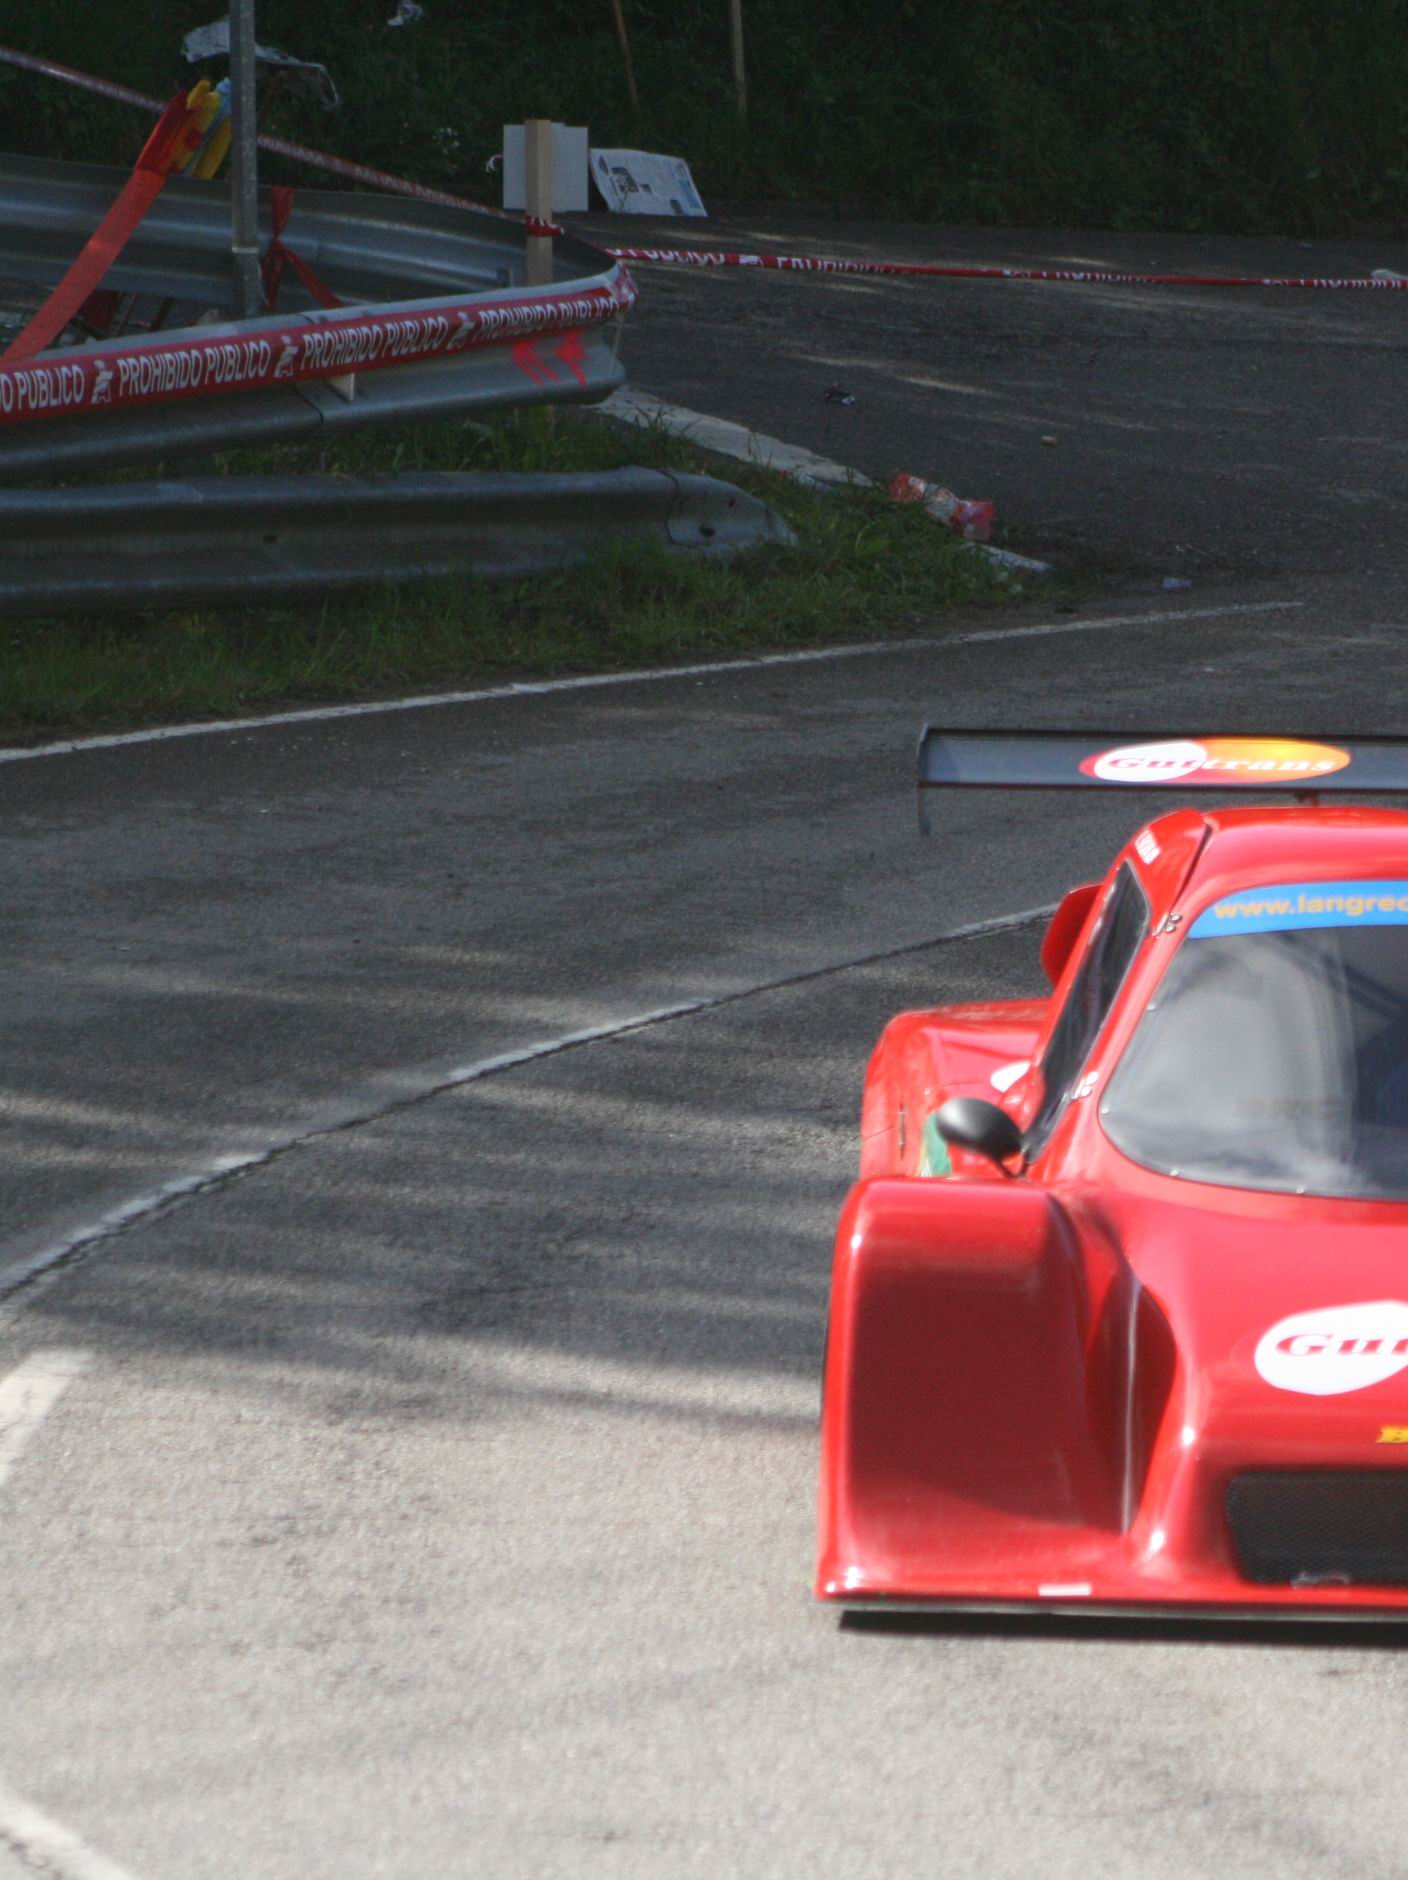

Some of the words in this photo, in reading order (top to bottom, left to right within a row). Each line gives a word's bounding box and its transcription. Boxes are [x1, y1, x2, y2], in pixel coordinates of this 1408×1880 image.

[116, 350, 202, 397] PROHIBIDO
[203, 340, 271, 385] PUBLICO
[299, 325, 385, 370] PROHIBIDO
[384, 316, 450, 365] PUBLICO
[14, 364, 85, 411] PUBLICO
